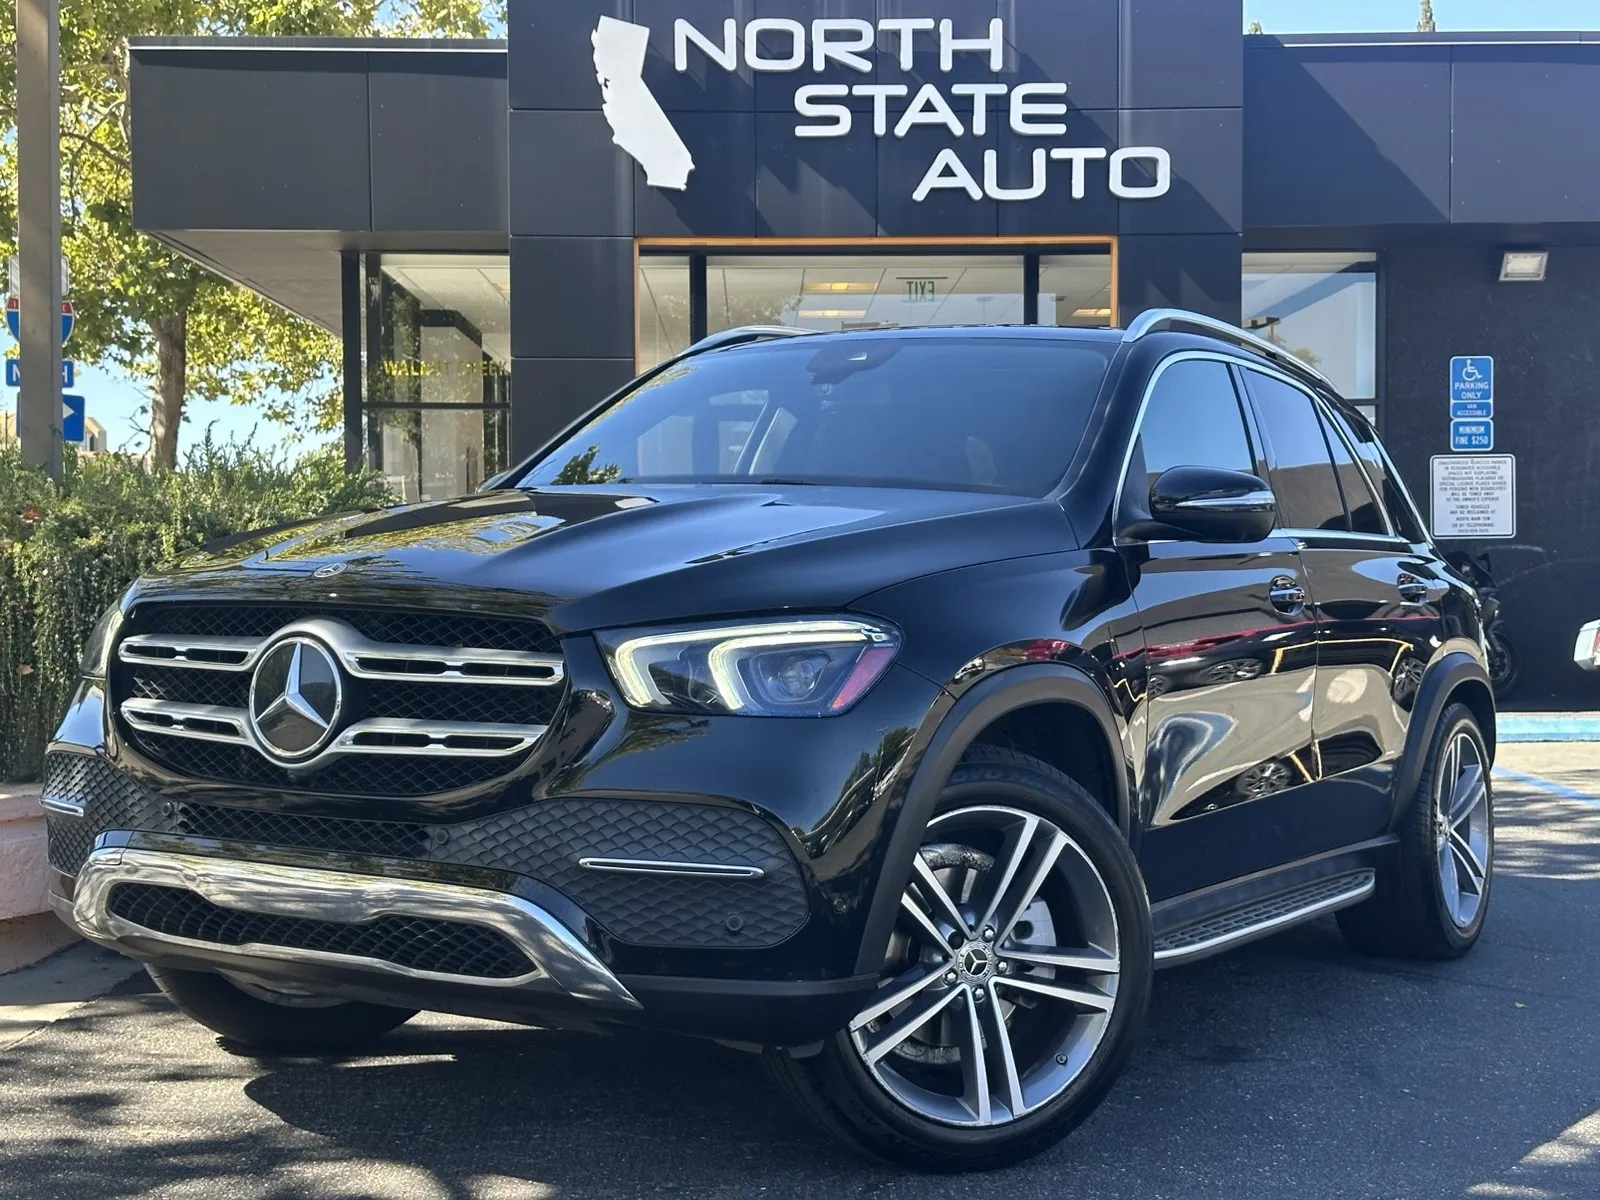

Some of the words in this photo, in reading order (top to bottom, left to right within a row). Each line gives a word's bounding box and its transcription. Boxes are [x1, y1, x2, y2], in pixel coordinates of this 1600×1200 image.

[674, 17, 1003, 73] NORTH
[794, 82, 1067, 137] STATE
[912, 146, 1171, 202] AUTO
[1455, 436, 1468, 444] FINE
[1472, 436, 1488, 444] $250
